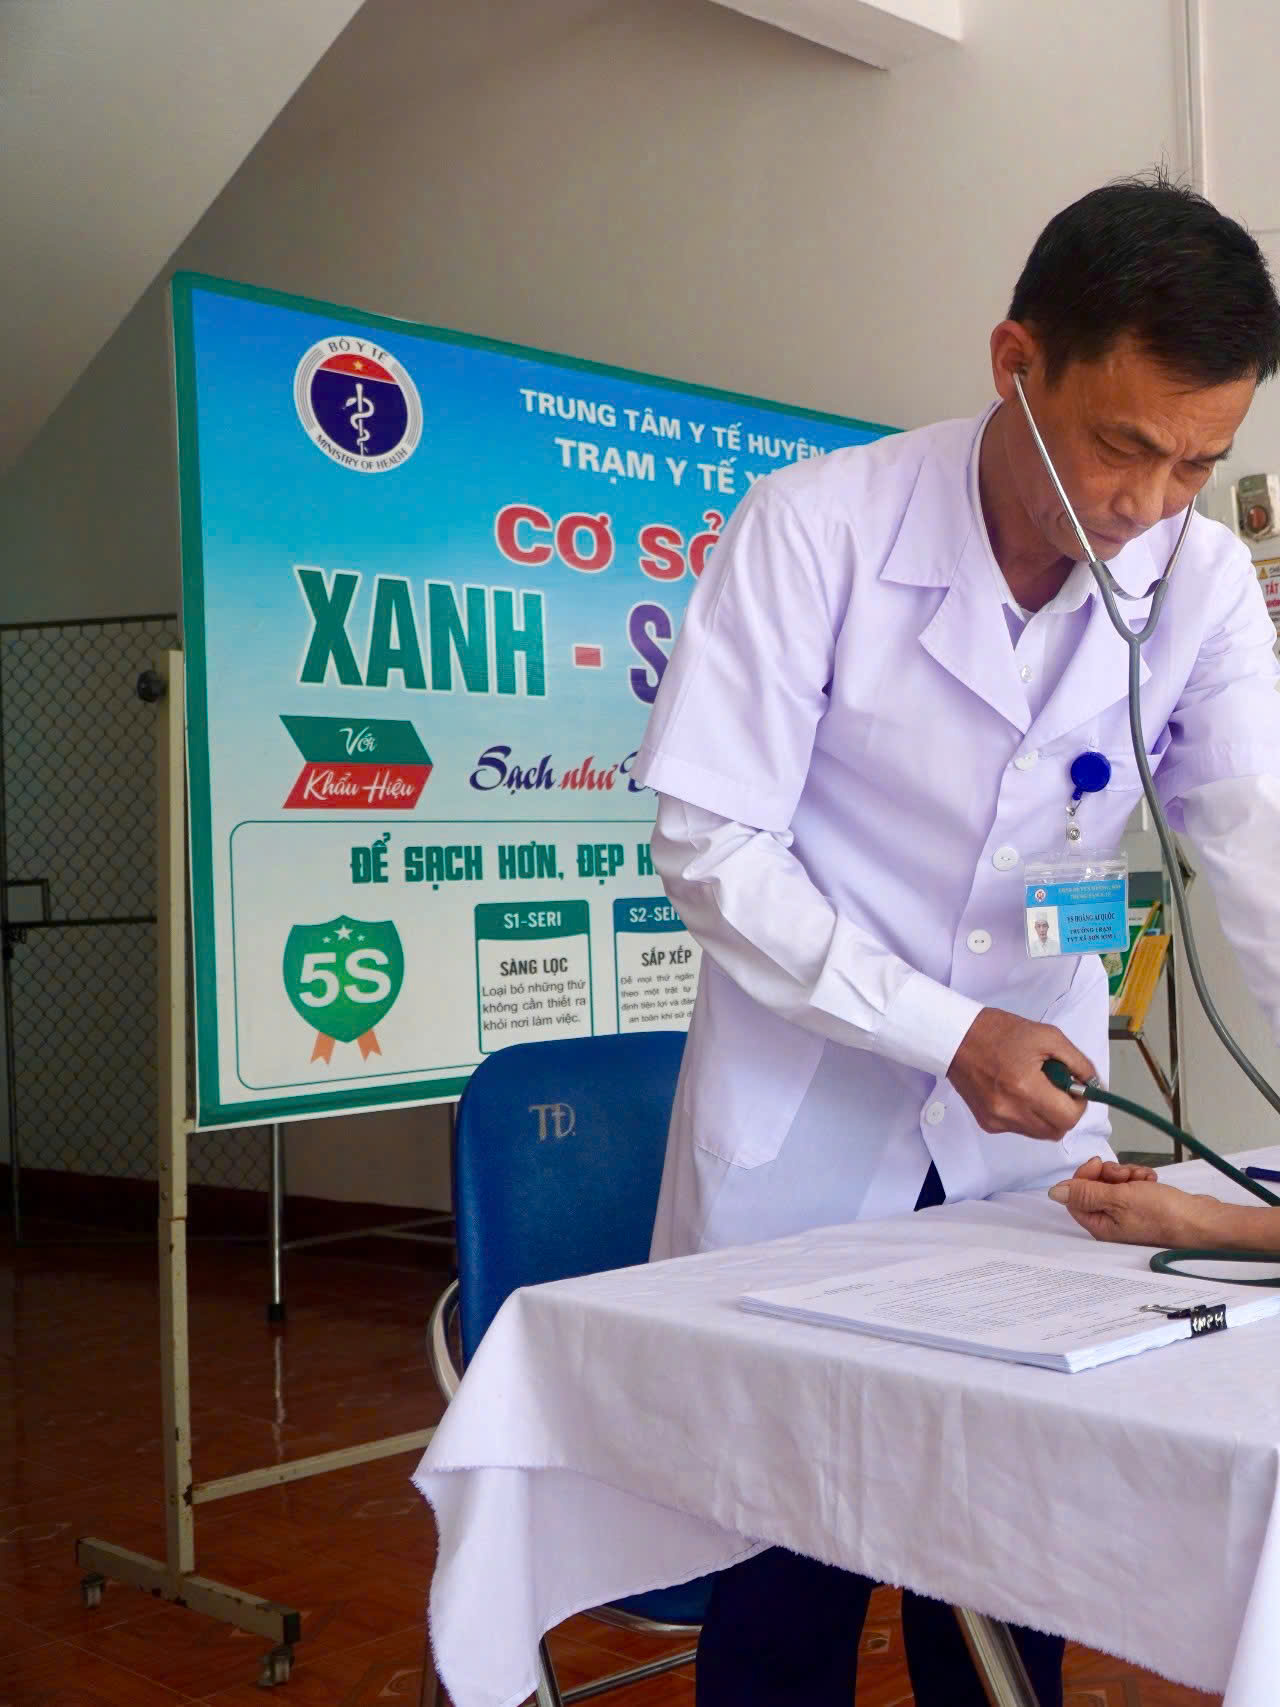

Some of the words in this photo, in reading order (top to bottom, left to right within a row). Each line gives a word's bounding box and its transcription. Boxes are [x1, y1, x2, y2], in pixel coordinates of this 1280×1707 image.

[356, 342, 366, 352] Y
[520, 388, 616, 428] TRUNG
[624, 408, 681, 441] TÂM
[688, 421, 705, 443] Y
[711, 422, 742, 452] TẾ
[316, 434, 359, 467] MINISTRY
[361, 459, 375, 470] OF
[376, 448, 409, 470] HEALTH
[554, 437, 656, 485] TRẠM
[665, 456, 688, 487] Y
[697, 457, 737, 494] TẾ
[496, 505, 614, 572] CƠ
[293, 566, 547, 698] XANH
[339, 727, 376, 755] Với
[303, 769, 360, 800] Khẩu
[360, 777, 415, 803] Hiệu
[470, 745, 557, 795] Sạch
[558, 755, 619, 791] như
[350, 832, 391, 884] ĐỂ
[404, 845, 484, 891] SẠCH
[498, 840, 564, 880] HƠN,
[576, 843, 625, 886] ĐẸP
[503, 911, 562, 929] S1-SERI
[500, 958, 537, 977] SÀNG
[542, 957, 568, 976] LỌC
[641, 946, 665, 967] SẮP
[669, 944, 692, 965] XẾP
[299, 948, 391, 1008] 5S
[482, 985, 507, 998] Loại
[510, 983, 525, 995] bỏ
[528, 981, 564, 994] những
[482, 1002, 518, 1014] không
[522, 998, 543, 1010] cần
[547, 995, 571, 1008] thiết
[575, 997, 586, 1006] ra
[483, 1019, 508, 1031] khỏi
[510, 1017, 529, 1028] nơi
[532, 1016, 553, 1027] làm
